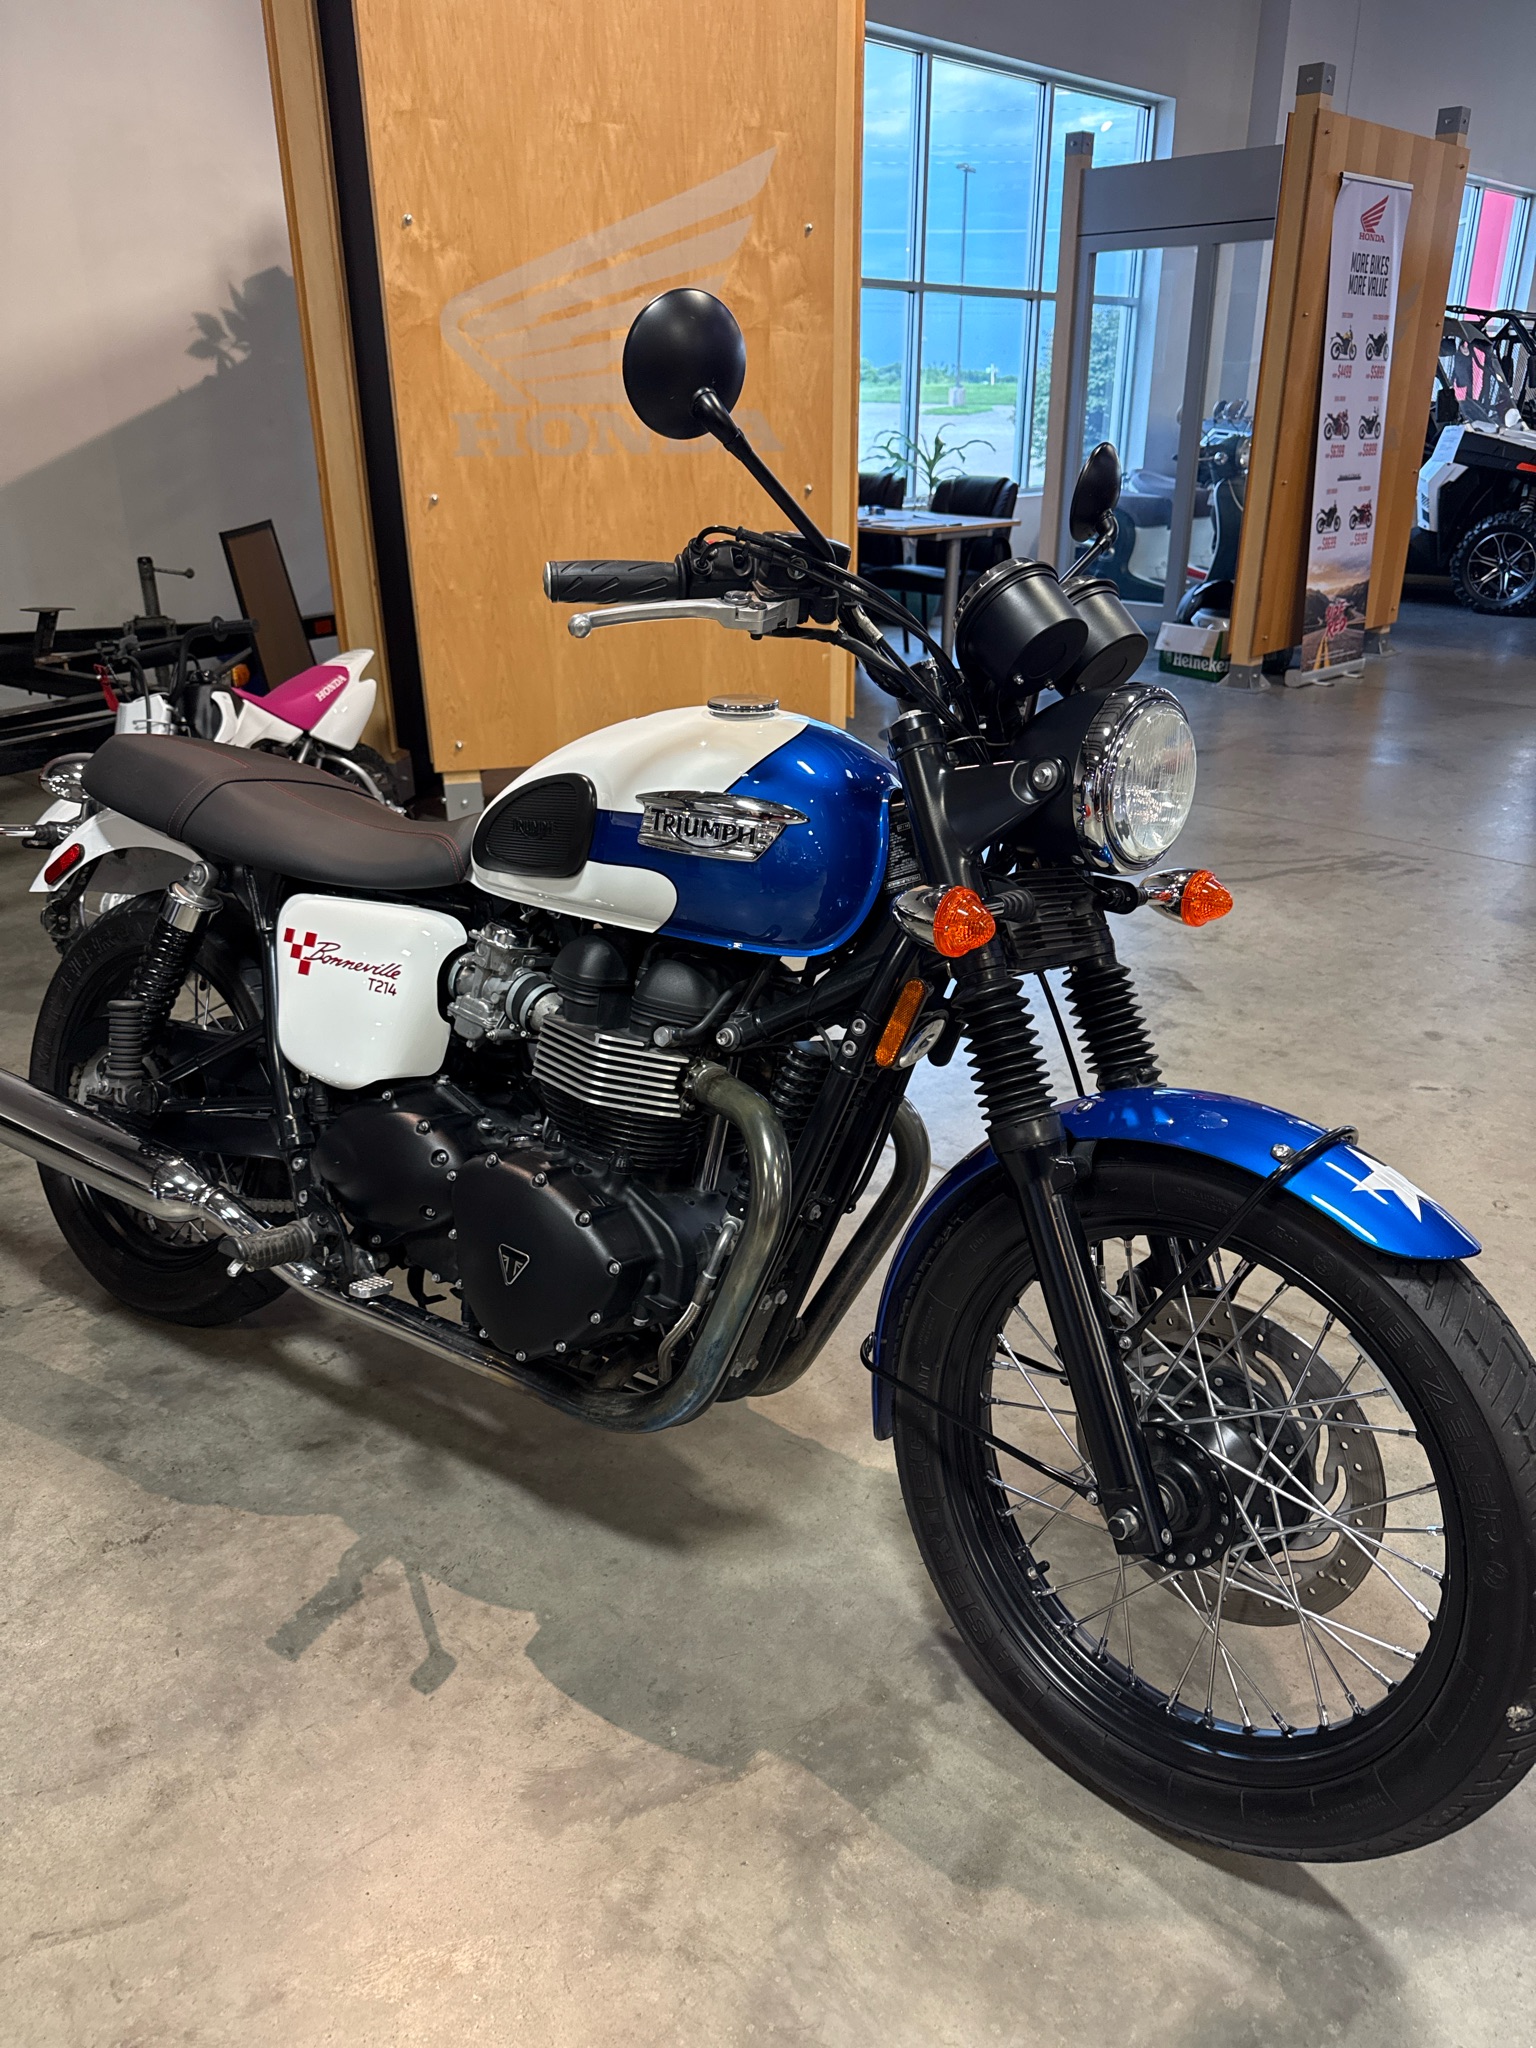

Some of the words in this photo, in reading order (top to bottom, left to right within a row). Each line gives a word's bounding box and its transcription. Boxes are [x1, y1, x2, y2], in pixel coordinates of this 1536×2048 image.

[1358, 231, 1385, 243] HONDA
[1350, 252, 1370, 274] MORE
[1369, 253, 1390, 276] BIKES
[1348, 274, 1367, 296] MORE
[1367, 276, 1388, 298] VALUE
[1326, 617, 1348, 639] RED
[315, 674, 348, 702] HONDA
[651, 808, 756, 848] TRIUMPH
[303, 941, 402, 980] Bonneville
[368, 977, 397, 996] T214
[1345, 1275, 1505, 1546] METZELER
[904, 1424, 1044, 1702] LASERTEC
